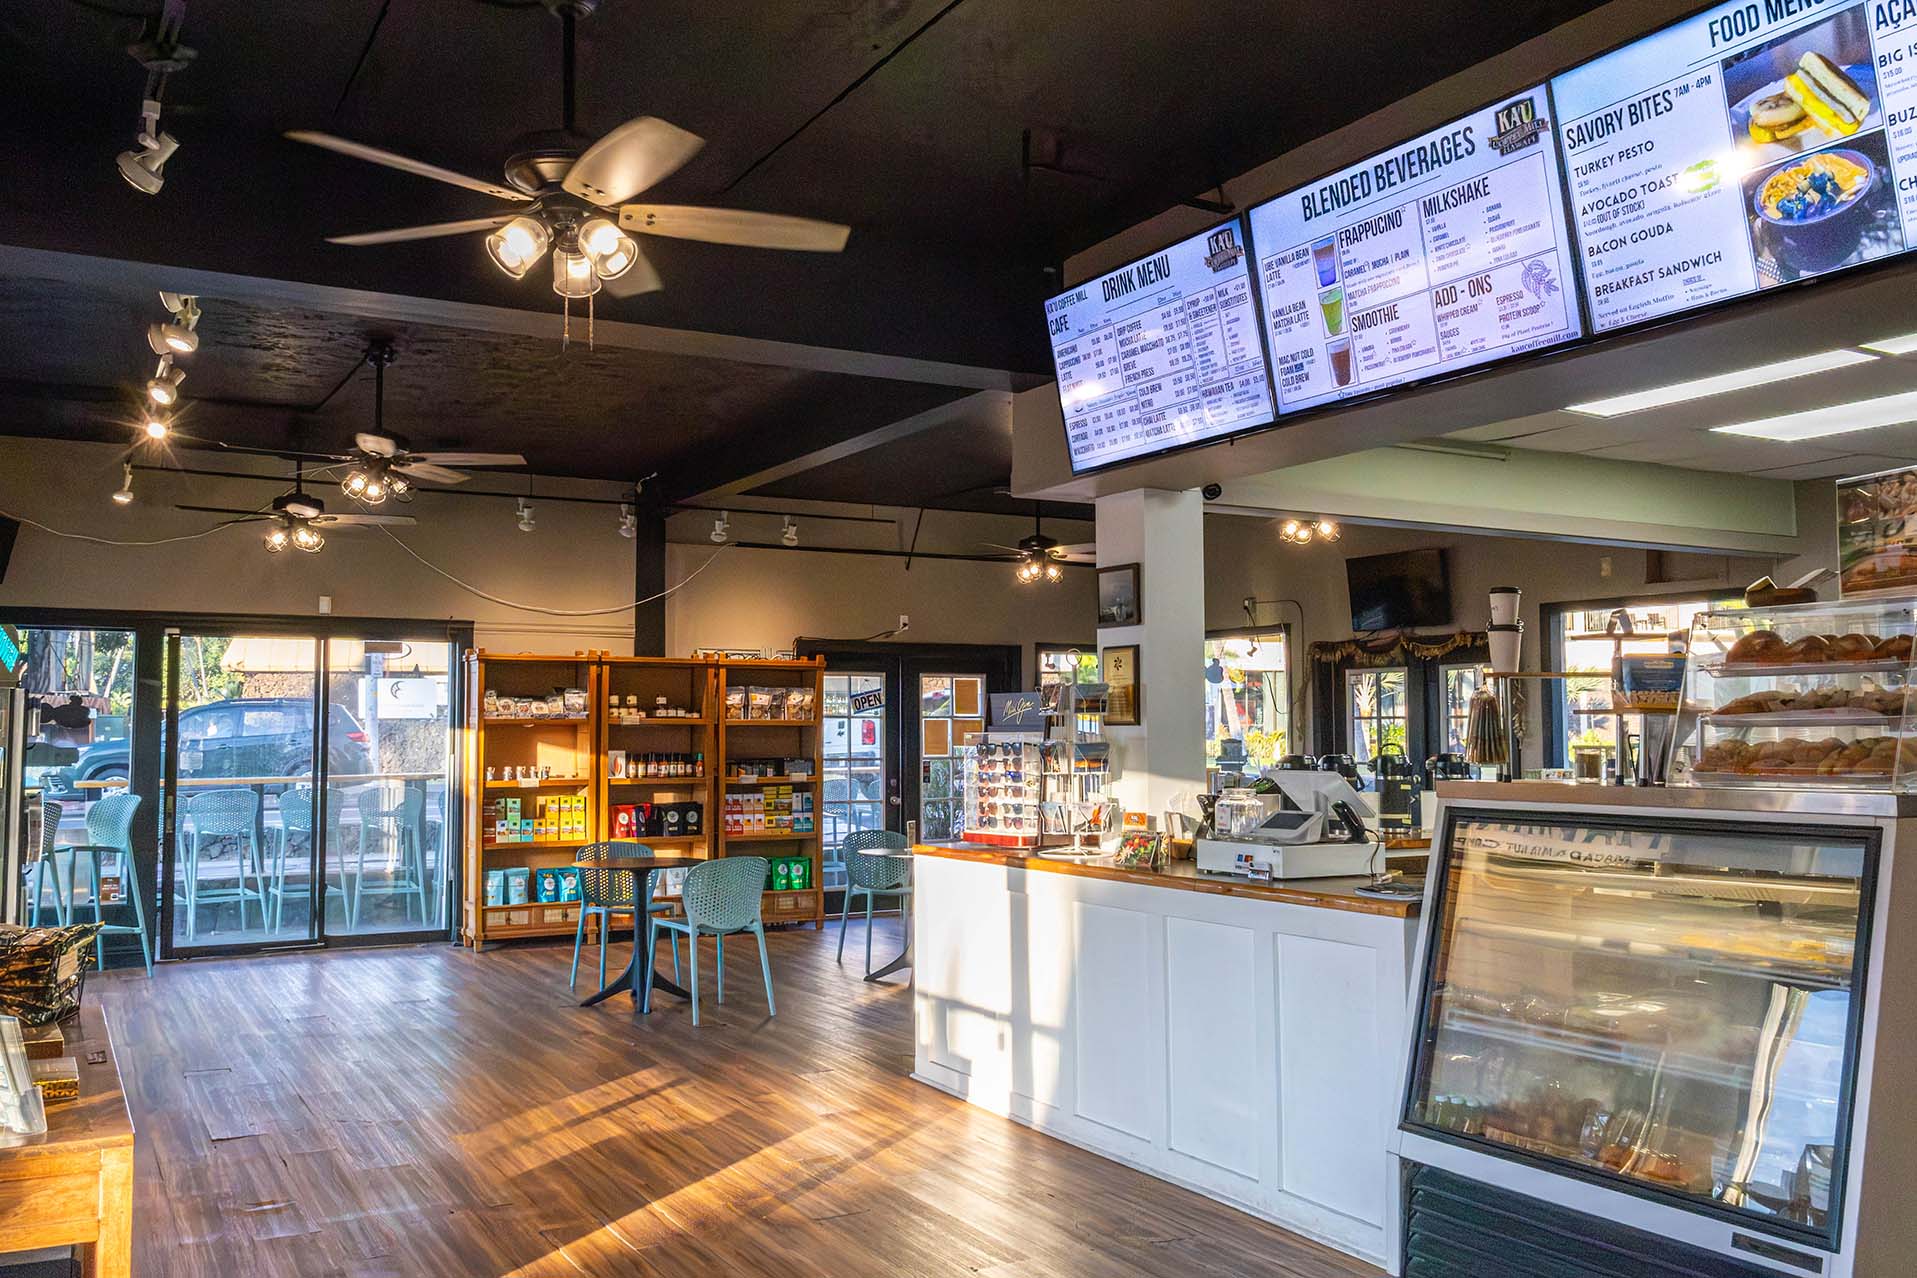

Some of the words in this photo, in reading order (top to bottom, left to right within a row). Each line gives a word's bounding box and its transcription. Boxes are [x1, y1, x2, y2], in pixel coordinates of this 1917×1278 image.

[1708, 4, 1760, 48] FOOD
[1765, 0, 1824, 24] ME
[1879, 49, 1903, 68] BIG
[1566, 109, 1624, 150] SAVORY
[1629, 90, 1673, 128] BITES
[1674, 81, 1690, 98] 7AM
[1696, 75, 1712, 91] 4PM
[1888, 106, 1917, 126] BUZ
[1575, 152, 1615, 178] TURKEY
[1618, 140, 1655, 164] PESTO
[1301, 168, 1371, 221] BLENDED
[1374, 124, 1476, 193] BEVERAGES
[1422, 176, 1490, 218] MILKSHAKE
[1582, 188, 1638, 216] AVOCADO
[1640, 173, 1678, 195] TOAST
[1612, 208, 1620, 219] OF
[1339, 209, 1402, 248] FRAPPUCINO
[1588, 240, 1627, 257] BACON
[1631, 222, 1673, 244] GOUDA
[1275, 252, 1295, 267] VANILLA
[1295, 246, 1309, 260] BEAN
[1344, 264, 1366, 279] CARAMEL
[1371, 256, 1388, 269] MOCHA
[1394, 248, 1409, 261] PLAIN
[1101, 269, 1135, 302] DRINK
[1136, 254, 1170, 288] MENU
[1266, 269, 1280, 282] LATTE
[1595, 270, 1655, 297] BREAKFAST
[1658, 250, 1722, 278] SANDWICH
[1057, 293, 1075, 309] COFFEE
[1075, 288, 1087, 302] MILL
[1217, 287, 1228, 298] MILK
[1219, 292, 1247, 308] SUBSTITUTES
[1433, 285, 1457, 308] ADD
[1467, 274, 1492, 298] ONS
[1496, 290, 1523, 305] ESPRESSO
[1186, 298, 1200, 309] SYRUP
[1192, 303, 1216, 318] SWEETENER
[1272, 304, 1291, 319] VANILLA
[1292, 299, 1305, 312] BEAN
[1437, 309, 1459, 322] WHIPPED
[1460, 303, 1478, 315] CREAM
[1273, 315, 1293, 330] MATCHA
[1294, 310, 1309, 323] LATTE
[1351, 303, 1399, 332] SMOOTHIE
[1498, 309, 1521, 323] PROTEIN
[1522, 304, 1540, 316] SCOOP
[1049, 314, 1069, 335] CAFE
[1117, 326, 1126, 335] DRIP
[1126, 320, 1141, 332] COFFEE
[1440, 327, 1459, 340] SAUCES
[1119, 336, 1133, 347] MOCHA
[1120, 346, 1139, 359] CARAMEL
[1139, 337, 1164, 353] MACCHIATO
[1123, 360, 1136, 371] BREVE
[1278, 354, 1289, 365] MAC
[1290, 351, 1300, 362] NUT
[1300, 347, 1313, 358] COLD
[1060, 370, 1072, 381] LATTE
[1124, 371, 1140, 383] FRENCH
[1140, 366, 1154, 378] PRESS
[1280, 365, 1293, 376] FOAM
[1282, 376, 1294, 387] COLD
[1295, 372, 1309, 383] BREW
[1138, 386, 1149, 396] COLD
[1149, 382, 1162, 393] BREW
[1224, 381, 1234, 391] TEA
[1069, 418, 1087, 430] ESPRESSO
[1153, 411, 1166, 422] LATTE
[1145, 426, 1162, 437] MATCHA
[854, 692, 882, 710] OPEN
